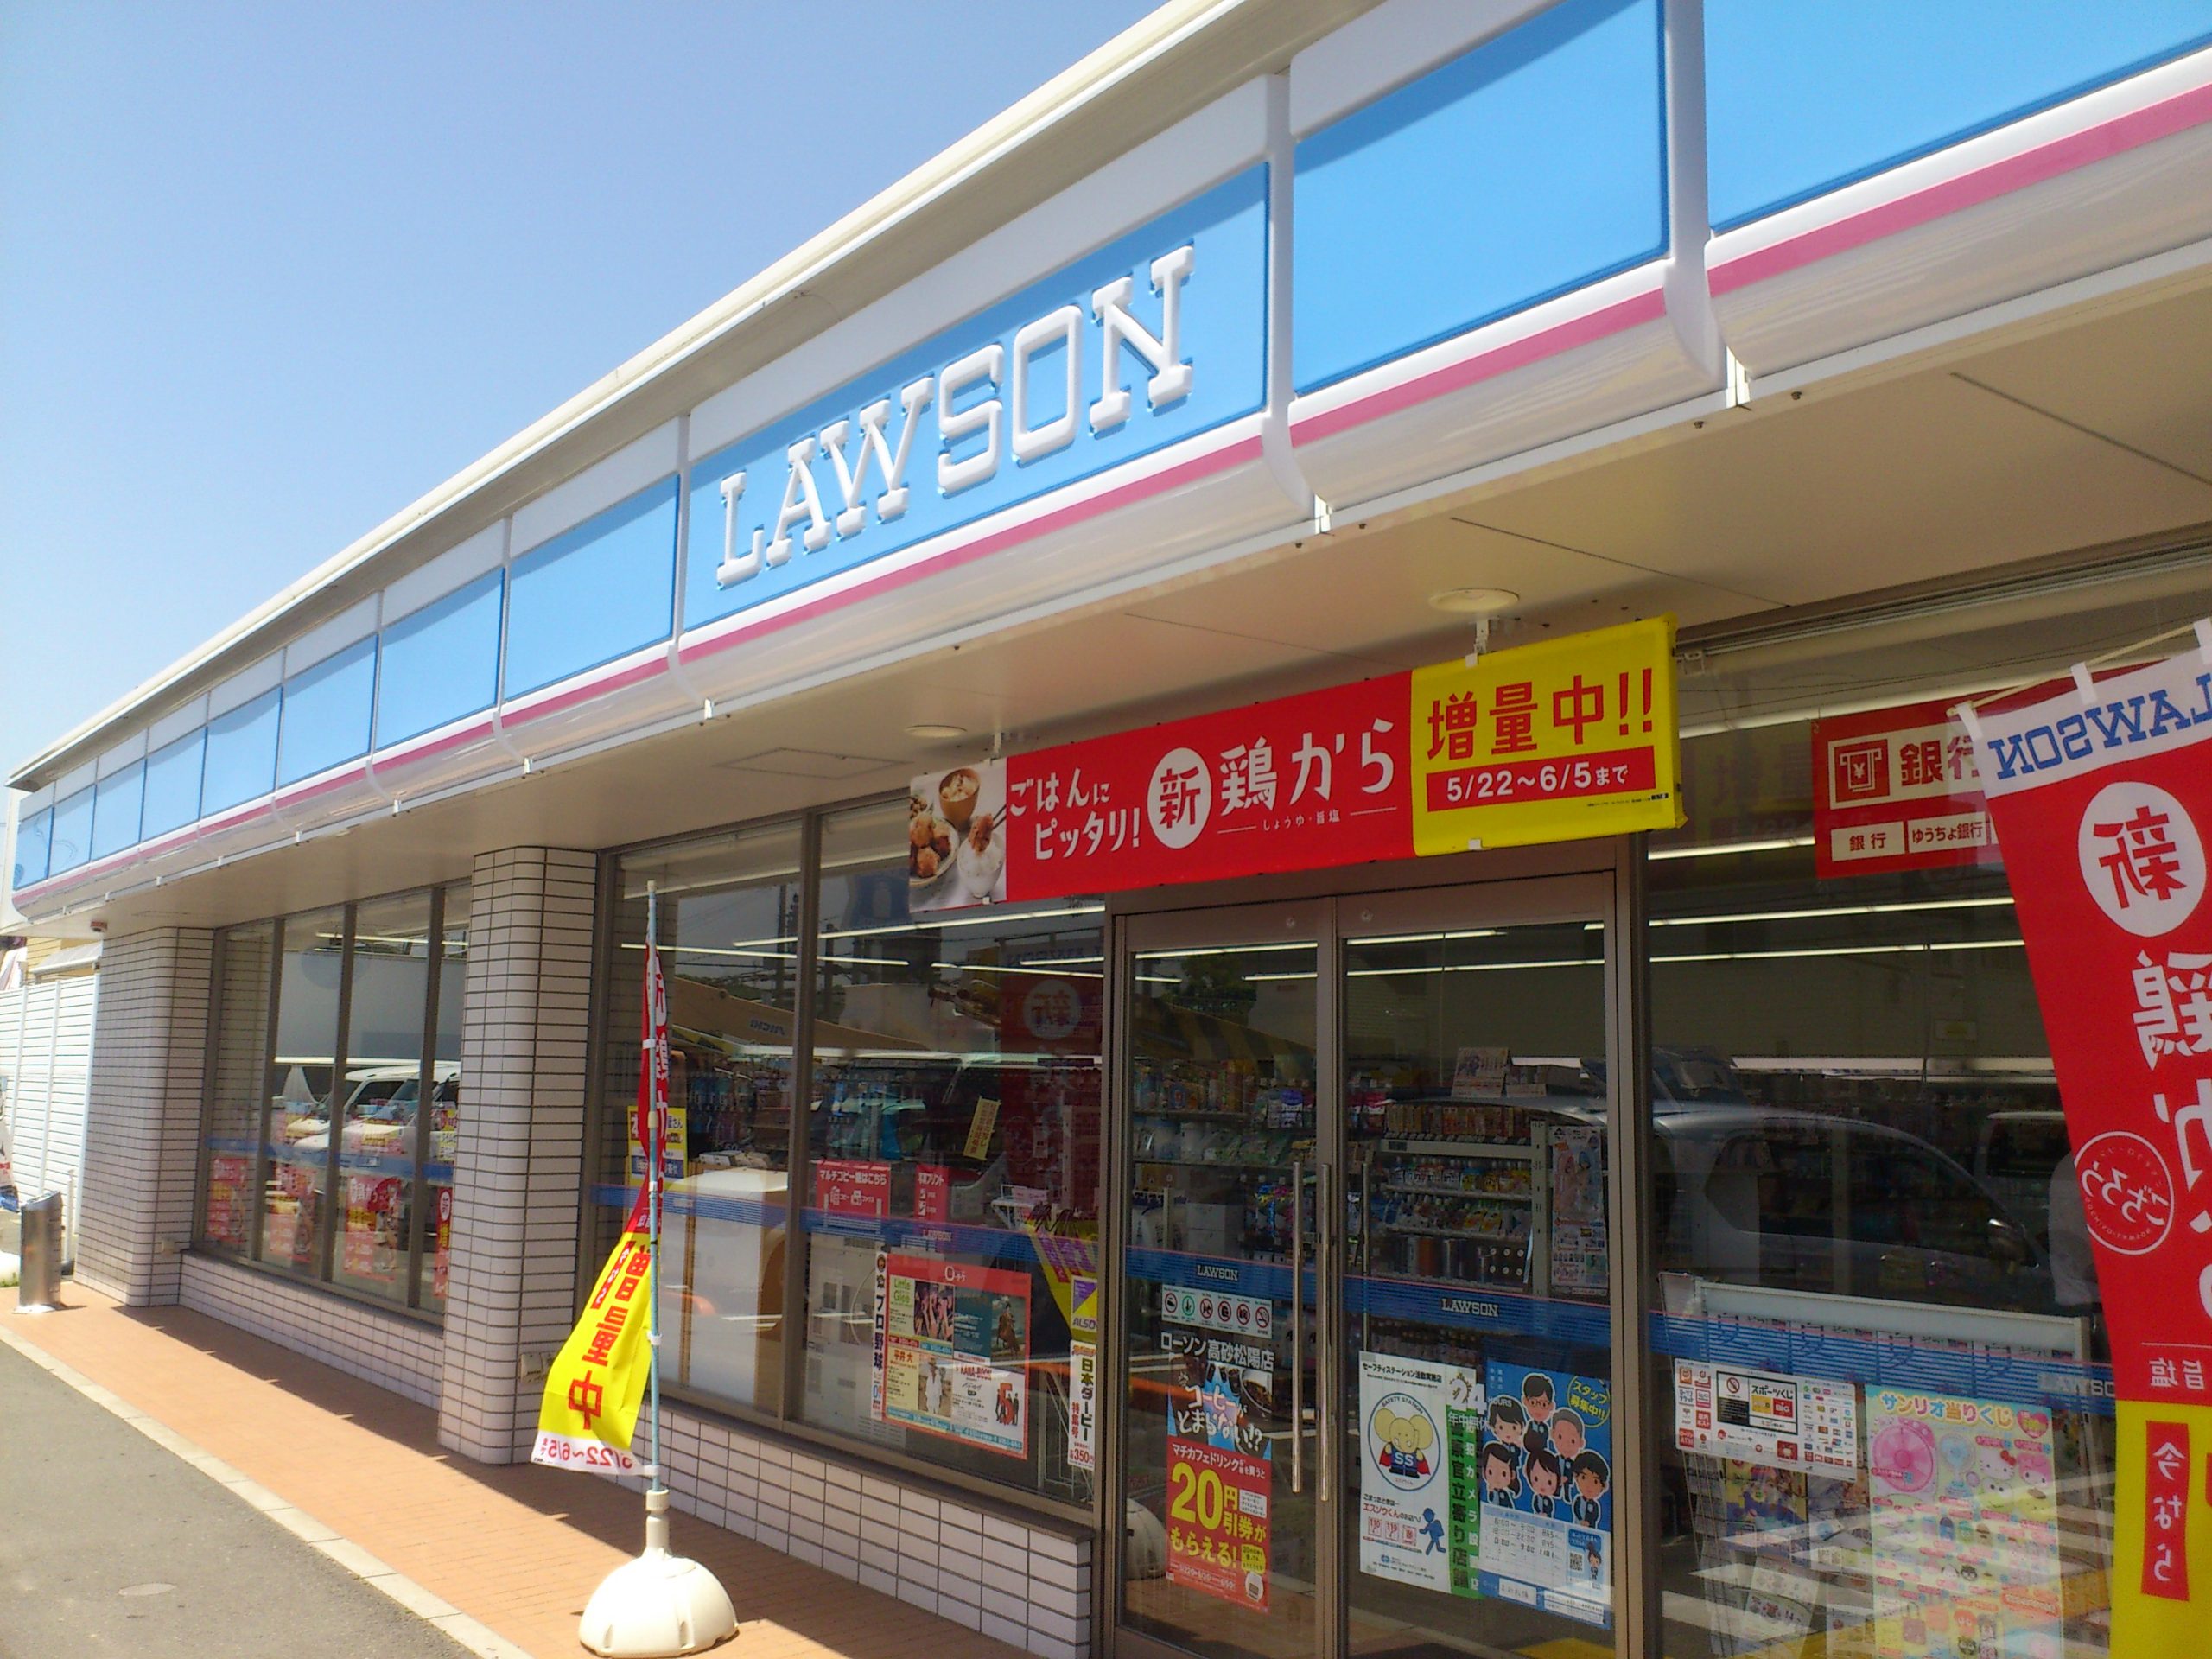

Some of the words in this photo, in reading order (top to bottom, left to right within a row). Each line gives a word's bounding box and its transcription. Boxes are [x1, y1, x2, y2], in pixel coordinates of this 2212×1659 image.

[717, 245, 1194, 588] LAWSON
[1427, 667, 1653, 760] 増量中!!
[1159, 766, 1202, 830] 新
[1219, 718, 1395, 817] 鶏から
[1009, 767, 1110, 817] ごはんに
[1035, 807, 1141, 861] ピッタリ!
[1848, 832, 1886, 852] 銀行
[1911, 822, 1983, 844] ゆうちょ銀行
[1197, 1265, 1239, 1281] LAWSON
[1441, 1298, 1499, 1317] LAWSON
[1072, 1316, 1097, 1331] ALSO
[1080, 1357, 1094, 1442] 日本ダービー
[1573, 1380, 1609, 1405] スタッフ
[1751, 1384, 1794, 1400] スポーツくじ
[1880, 1391, 2013, 1428] サンリオ当りくじ
[1394, 1453, 1414, 1467] SS
